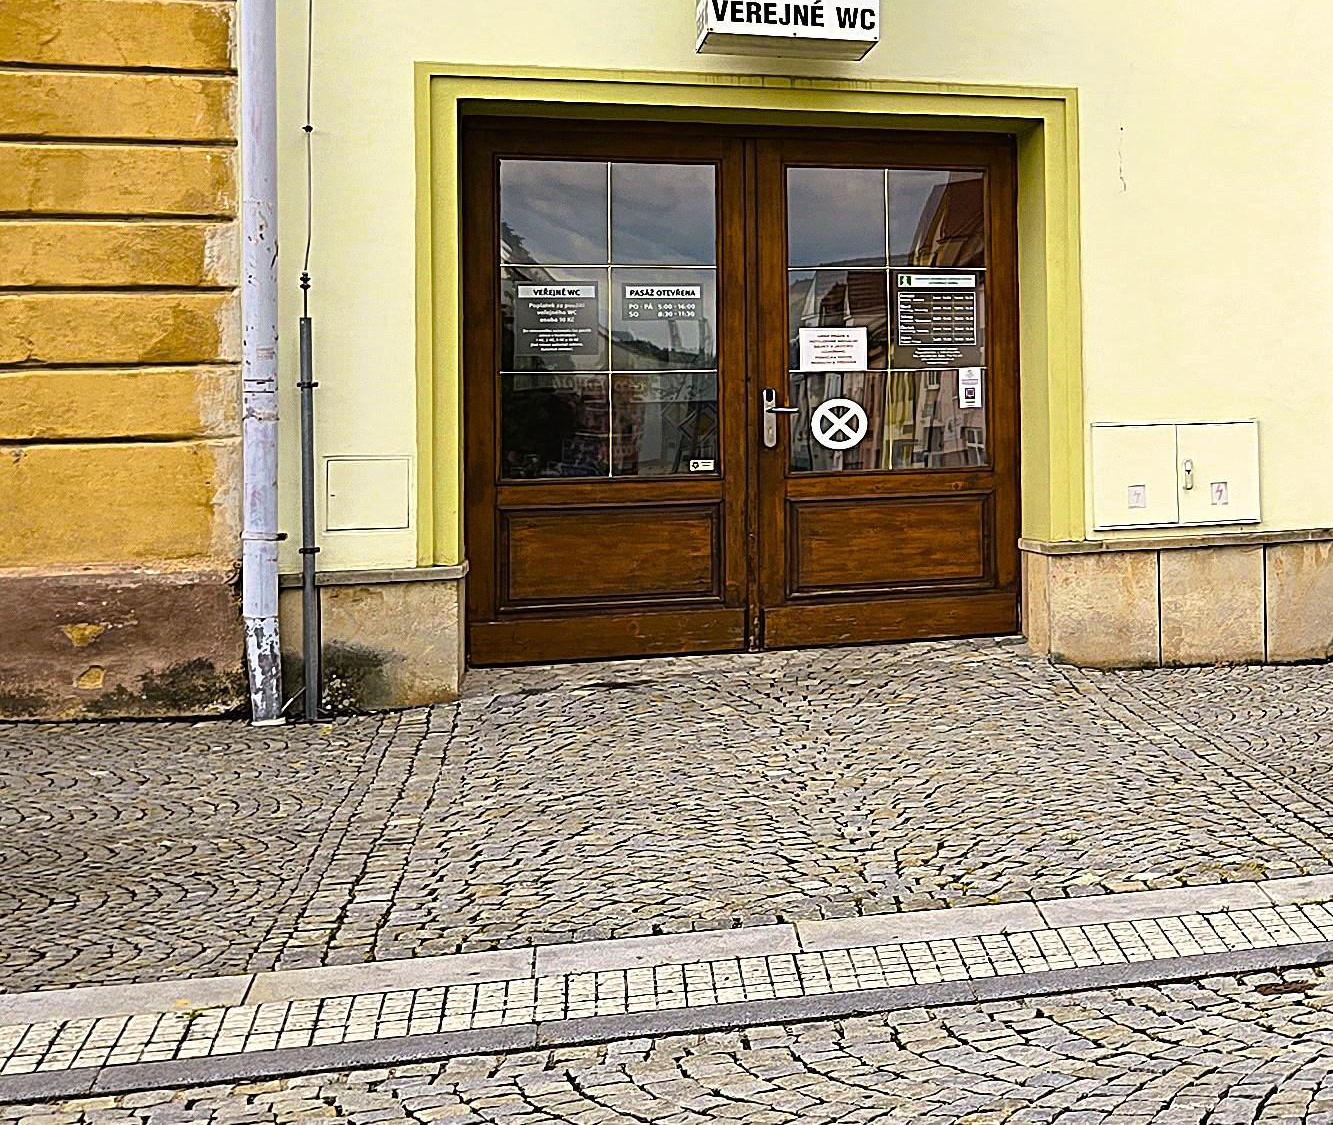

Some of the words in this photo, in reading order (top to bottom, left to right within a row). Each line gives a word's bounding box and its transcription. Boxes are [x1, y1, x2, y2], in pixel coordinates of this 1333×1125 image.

[835, 7, 876, 30] WC
[532, 287, 566, 296] VEŘEJNÉ
[629, 288, 654, 296] PASÁŽ
[656, 288, 696, 296] OTEVŘENA
